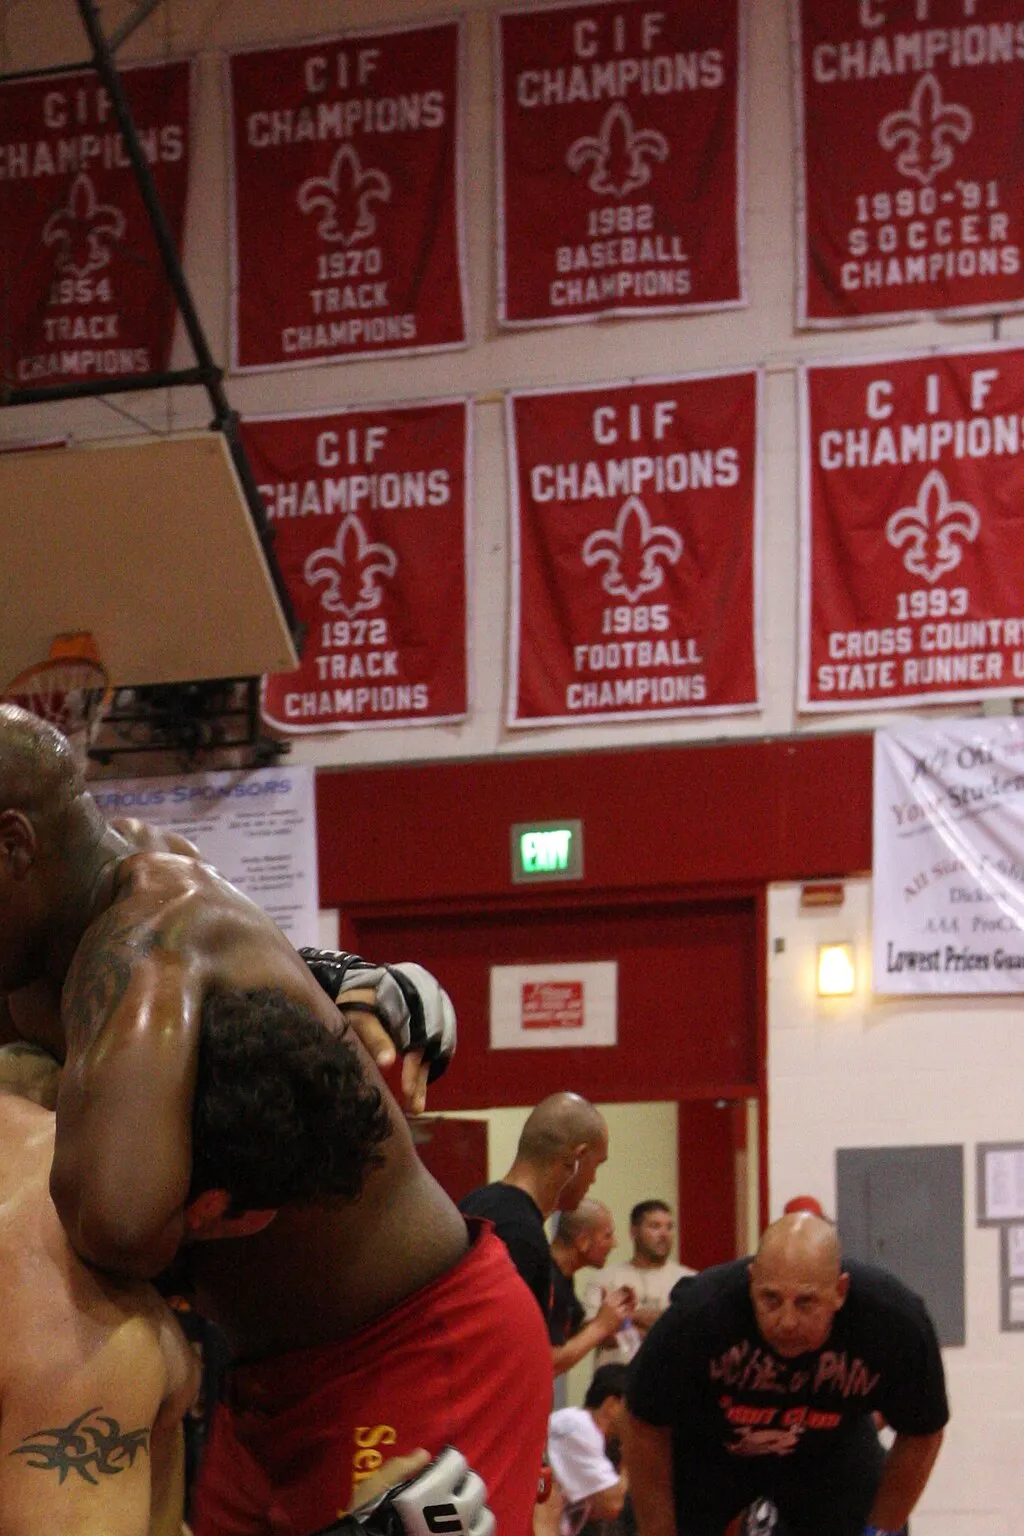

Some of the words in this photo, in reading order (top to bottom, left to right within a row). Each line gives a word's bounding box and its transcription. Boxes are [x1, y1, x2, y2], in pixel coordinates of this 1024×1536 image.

[305, 49, 380, 94] CIF
[517, 49, 724, 107] CHAMPIONS
[247, 91, 445, 148] CHAMPIONS
[588, 205, 653, 236] 1982
[848, 212, 1009, 256] SOCCER
[318, 249, 382, 281] 1970
[557, 237, 688, 272] BASEBALL
[841, 246, 1020, 290] CHAMPIONS
[310, 282, 388, 315] TRACK
[550, 270, 691, 307] CHAMPIONS
[43, 313, 119, 341] TRACK
[282, 316, 416, 353] CHAMPIONS
[17, 348, 153, 380] CHAMPIONS
[593, 402, 678, 445] CIF
[317, 427, 387, 467] CIF
[531, 447, 740, 502] CHAMPIONS
[602, 604, 670, 635] 1985
[897, 587, 969, 621] 1993
[322, 617, 388, 648] 1972
[829, 625, 912, 659] CROSS
[316, 650, 398, 681] TRACK
[575, 638, 703, 672] FOOTBALL
[818, 661, 896, 691] STATE
[904, 652, 1002, 686] RUNNER
[285, 684, 429, 717] CHAMPIONS
[567, 674, 706, 710] CHAMPIONS
[174, 779, 292, 803] SPONSORS
